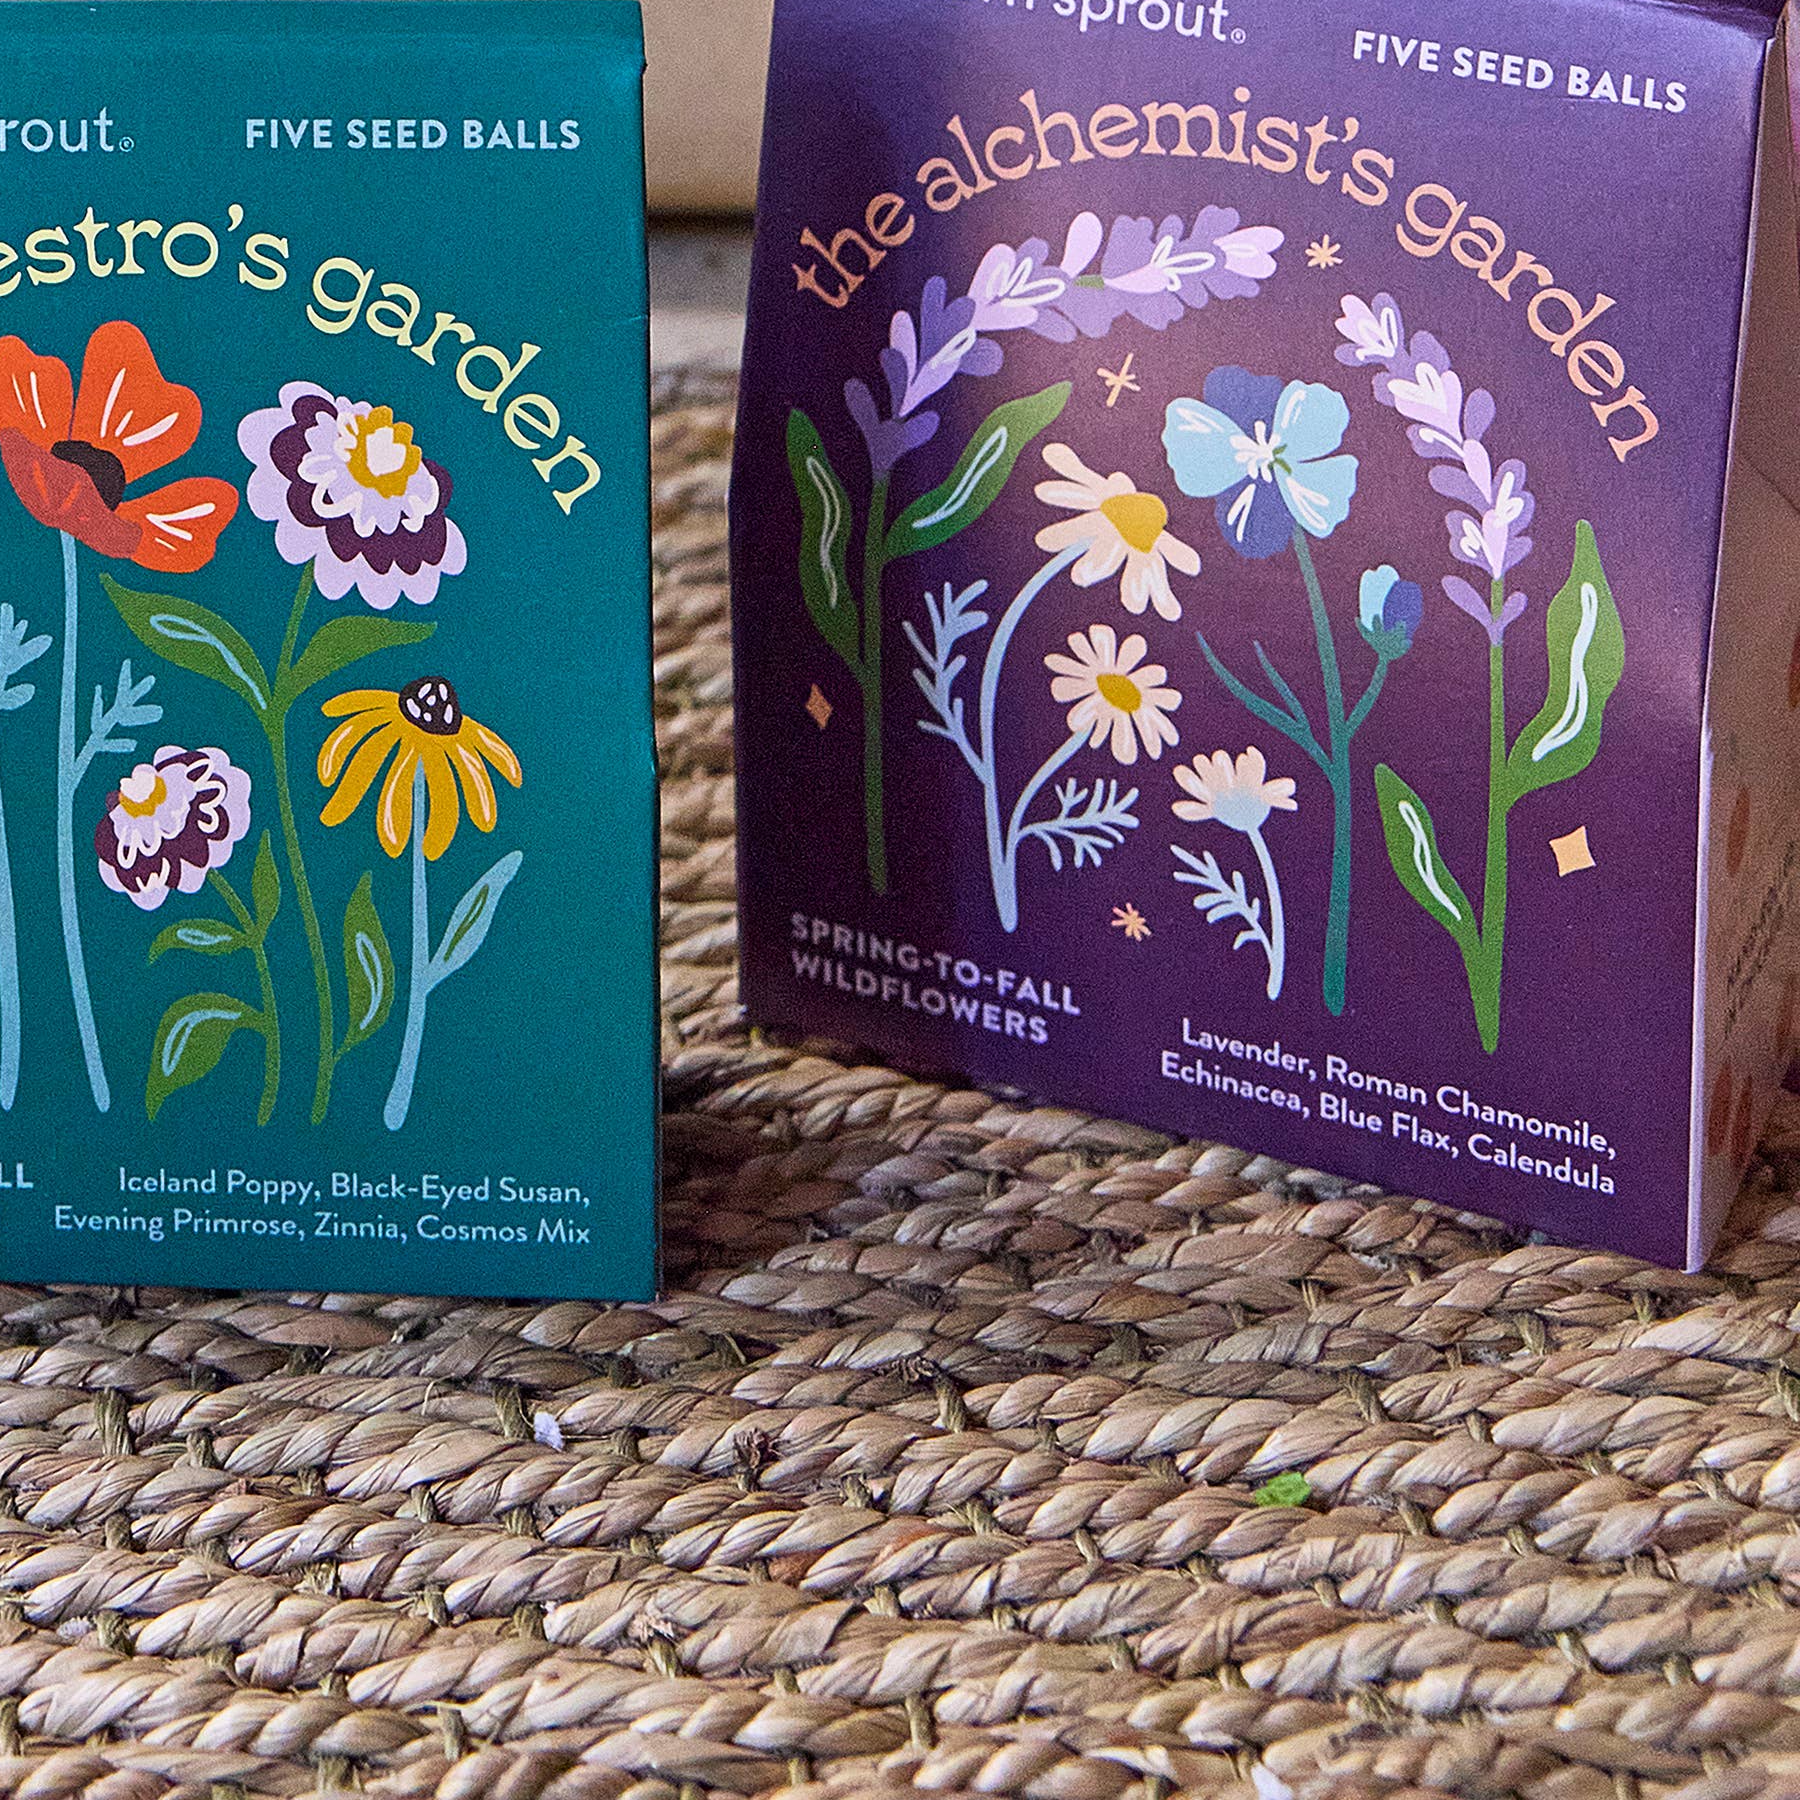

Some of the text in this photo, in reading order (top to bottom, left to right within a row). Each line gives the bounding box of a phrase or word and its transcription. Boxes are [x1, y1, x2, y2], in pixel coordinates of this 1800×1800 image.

[1354, 31, 1686, 112] FIVE SEED BALLS
[247, 119, 580, 149] FIVE SEED BALLS
[793, 193, 915, 308] the
[1396, 184, 1658, 462] garden
[307, 258, 600, 515] garden
[791, 912, 1081, 1015] SPRING-TO-FALL
[792, 952, 1049, 1045] WILDFLOWERS
[1162, 1050, 1614, 1194] Echinacea, Blue Flax, Calendula
[1183, 1018, 1615, 1160] Lavender, Roman Chamomile,
[55, 1205, 589, 1244] Evening Primrose, Zinnia, Cosmos Mix
[120, 1167, 589, 1208] Iceland Poppy, Black-Eyed Susan,
